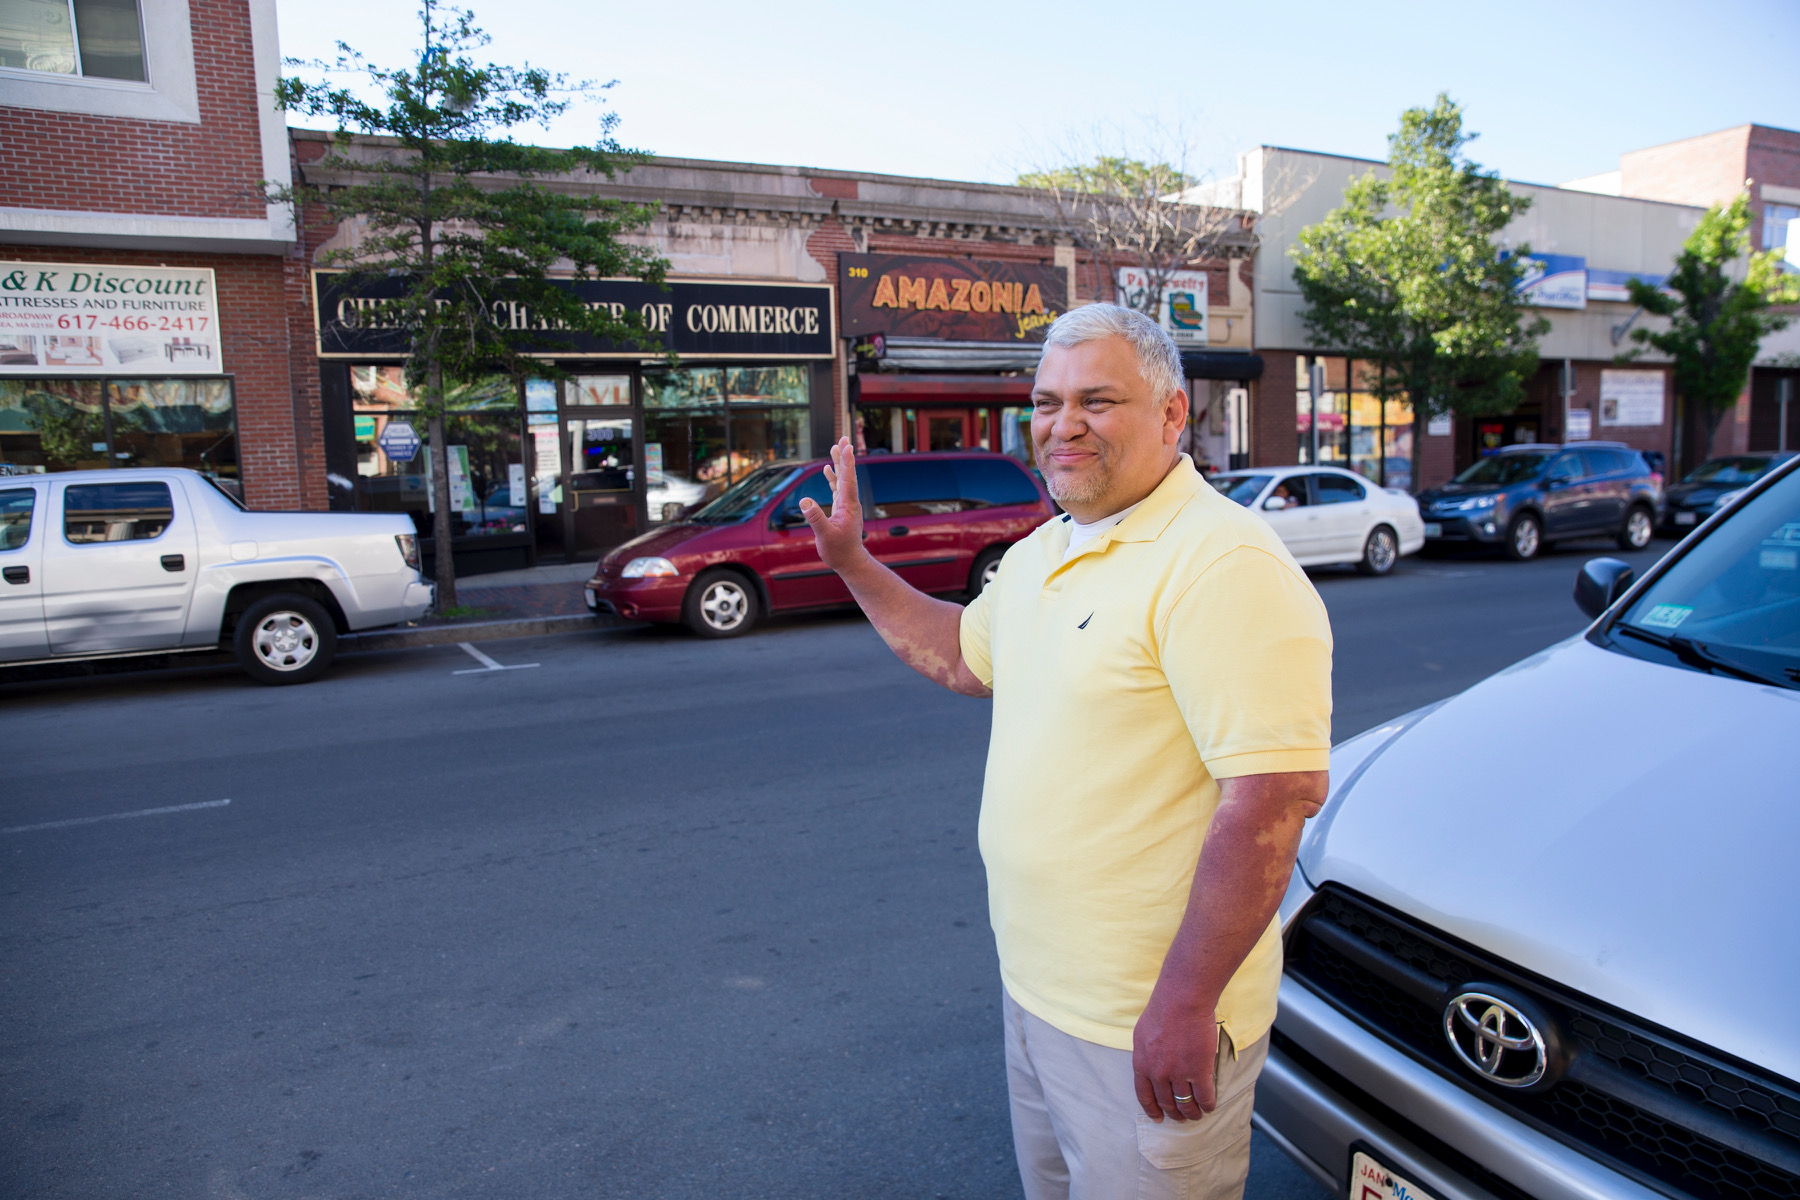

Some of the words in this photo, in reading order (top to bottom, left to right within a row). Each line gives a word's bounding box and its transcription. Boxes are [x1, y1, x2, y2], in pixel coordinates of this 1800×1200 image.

[1, 270, 28, 291] &
[33, 271, 59, 292] K
[67, 272, 207, 296] Discount
[848, 267, 869, 278] 310
[83, 298, 118, 309] AND
[122, 300, 207, 311] FURNITURE
[872, 274, 1045, 315] AMAZONIA
[57, 314, 209, 331] 617-466-2417
[640, 302, 673, 333] OF
[686, 304, 820, 335] COMMERCE
[1014, 309, 1059, 339] jeans
[1361, 1164, 1386, 1187] JAN
